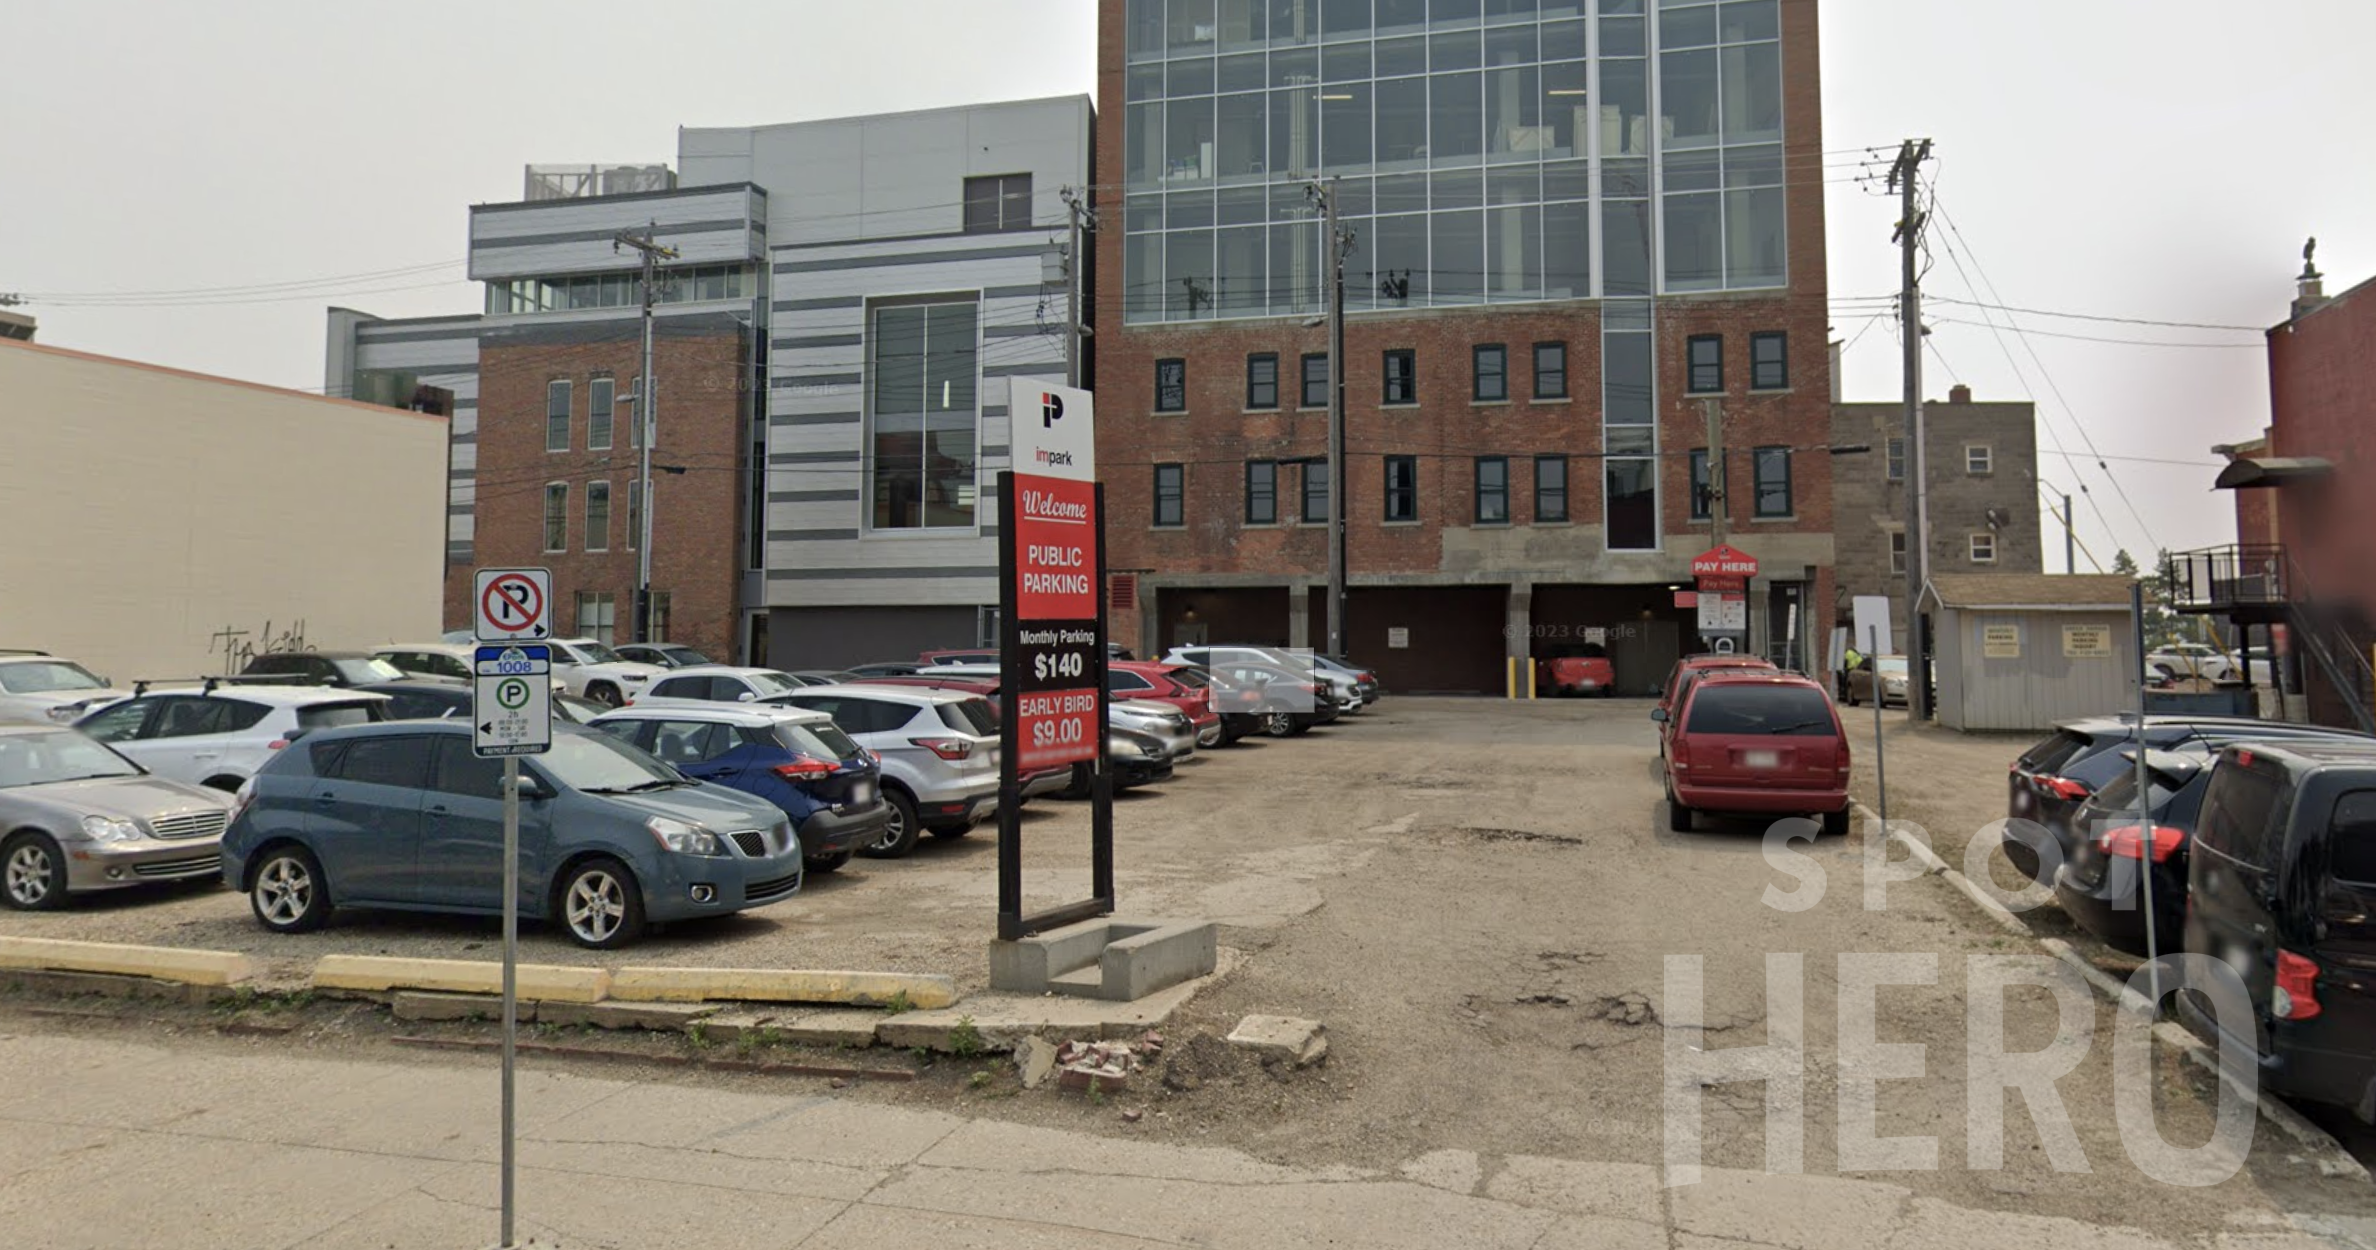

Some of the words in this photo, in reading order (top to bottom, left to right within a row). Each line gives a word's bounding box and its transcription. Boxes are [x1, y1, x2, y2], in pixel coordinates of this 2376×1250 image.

[1035, 446, 1072, 467] impark
[1022, 489, 1087, 519] Welcome
[1028, 545, 1082, 567] PUBLIC
[1694, 561, 1719, 572] PAY
[1721, 562, 1756, 572] HERE
[1023, 573, 1089, 594] PARKING
[1020, 630, 1058, 647] Monthly
[1060, 629, 1095, 646] Parking
[497, 660, 532, 673] 1008
[1034, 652, 1082, 681] $140
[506, 685, 522, 702] P
[1020, 697, 1062, 716] EARLY
[1064, 694, 1094, 714] BIRD
[1033, 717, 1082, 746] $9.00
